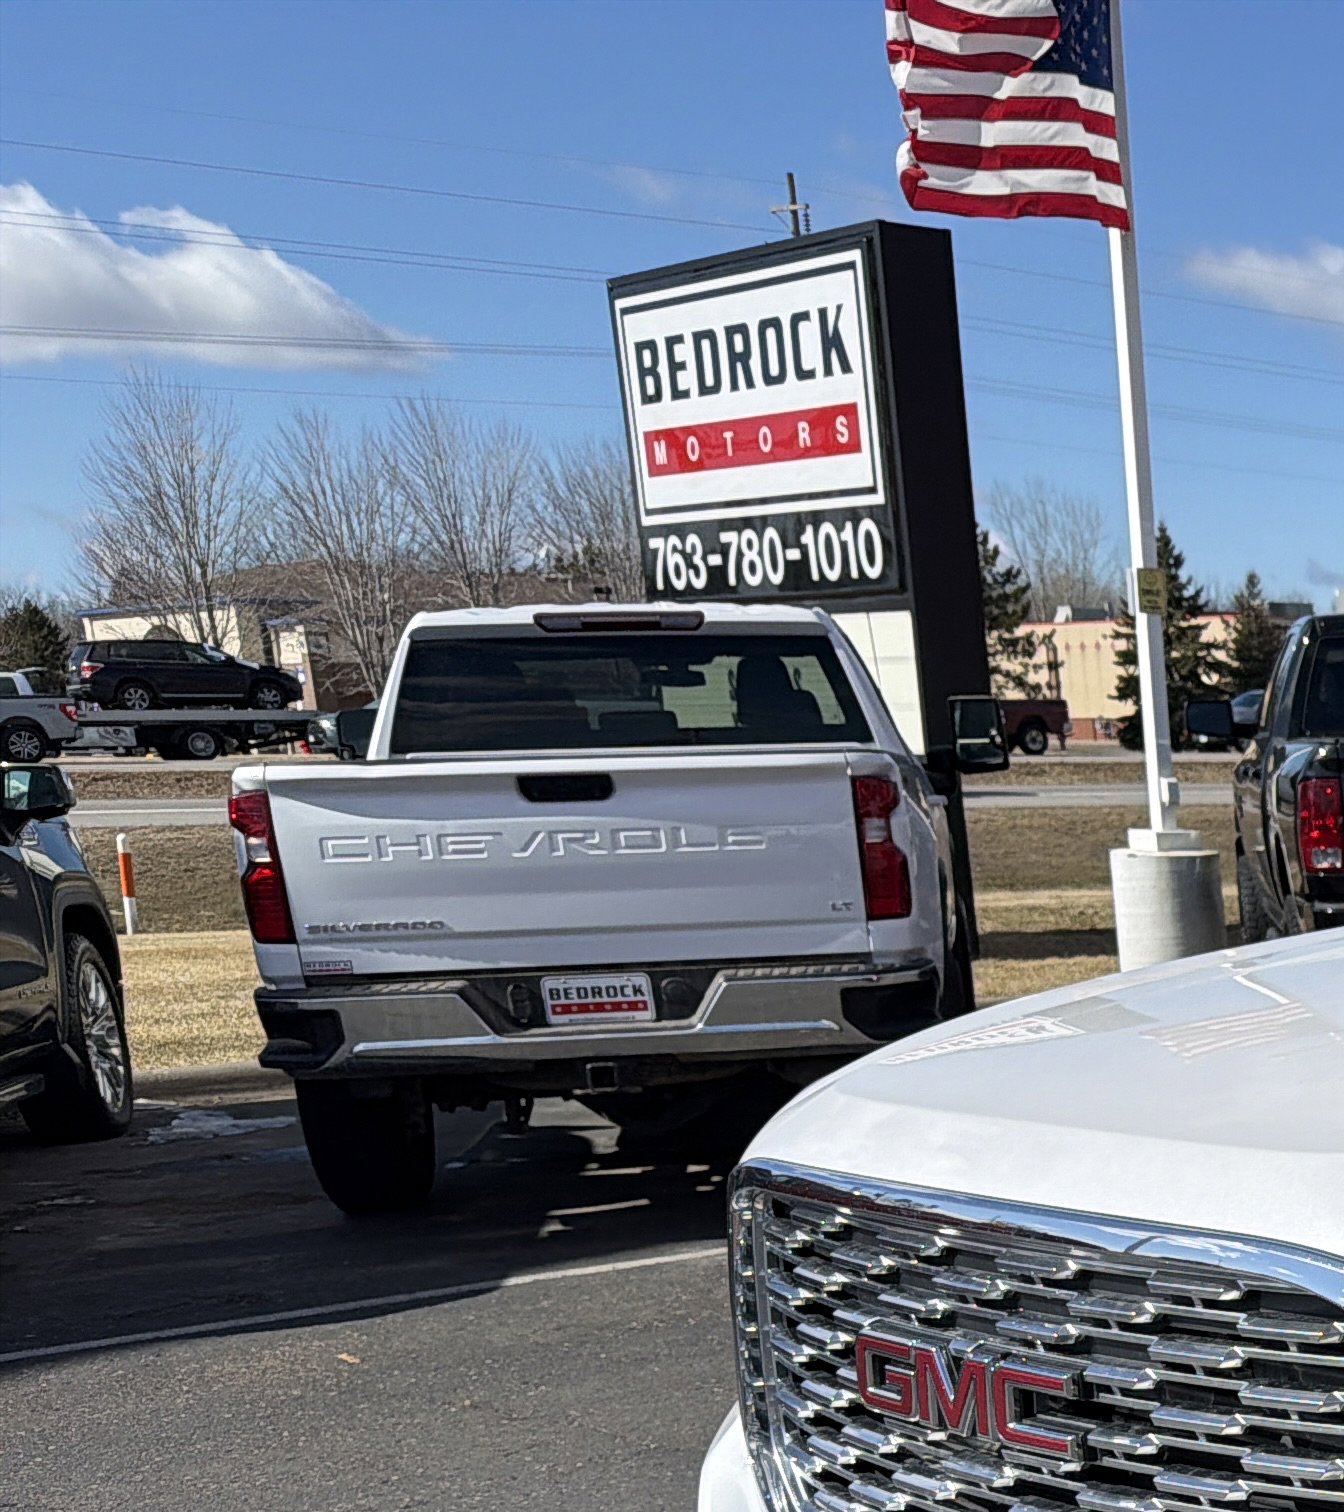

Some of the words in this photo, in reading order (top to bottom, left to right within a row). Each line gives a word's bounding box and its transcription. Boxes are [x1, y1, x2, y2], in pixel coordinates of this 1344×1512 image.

[634, 304, 853, 405] BEDROCK
[654, 415, 849, 466] MOTORS
[649, 517, 883, 591] 763-780-1010
[304, 921, 445, 934] SILVERADO
[548, 984, 646, 1001] BEDROCK
[855, 1332, 1078, 1460] GMC
